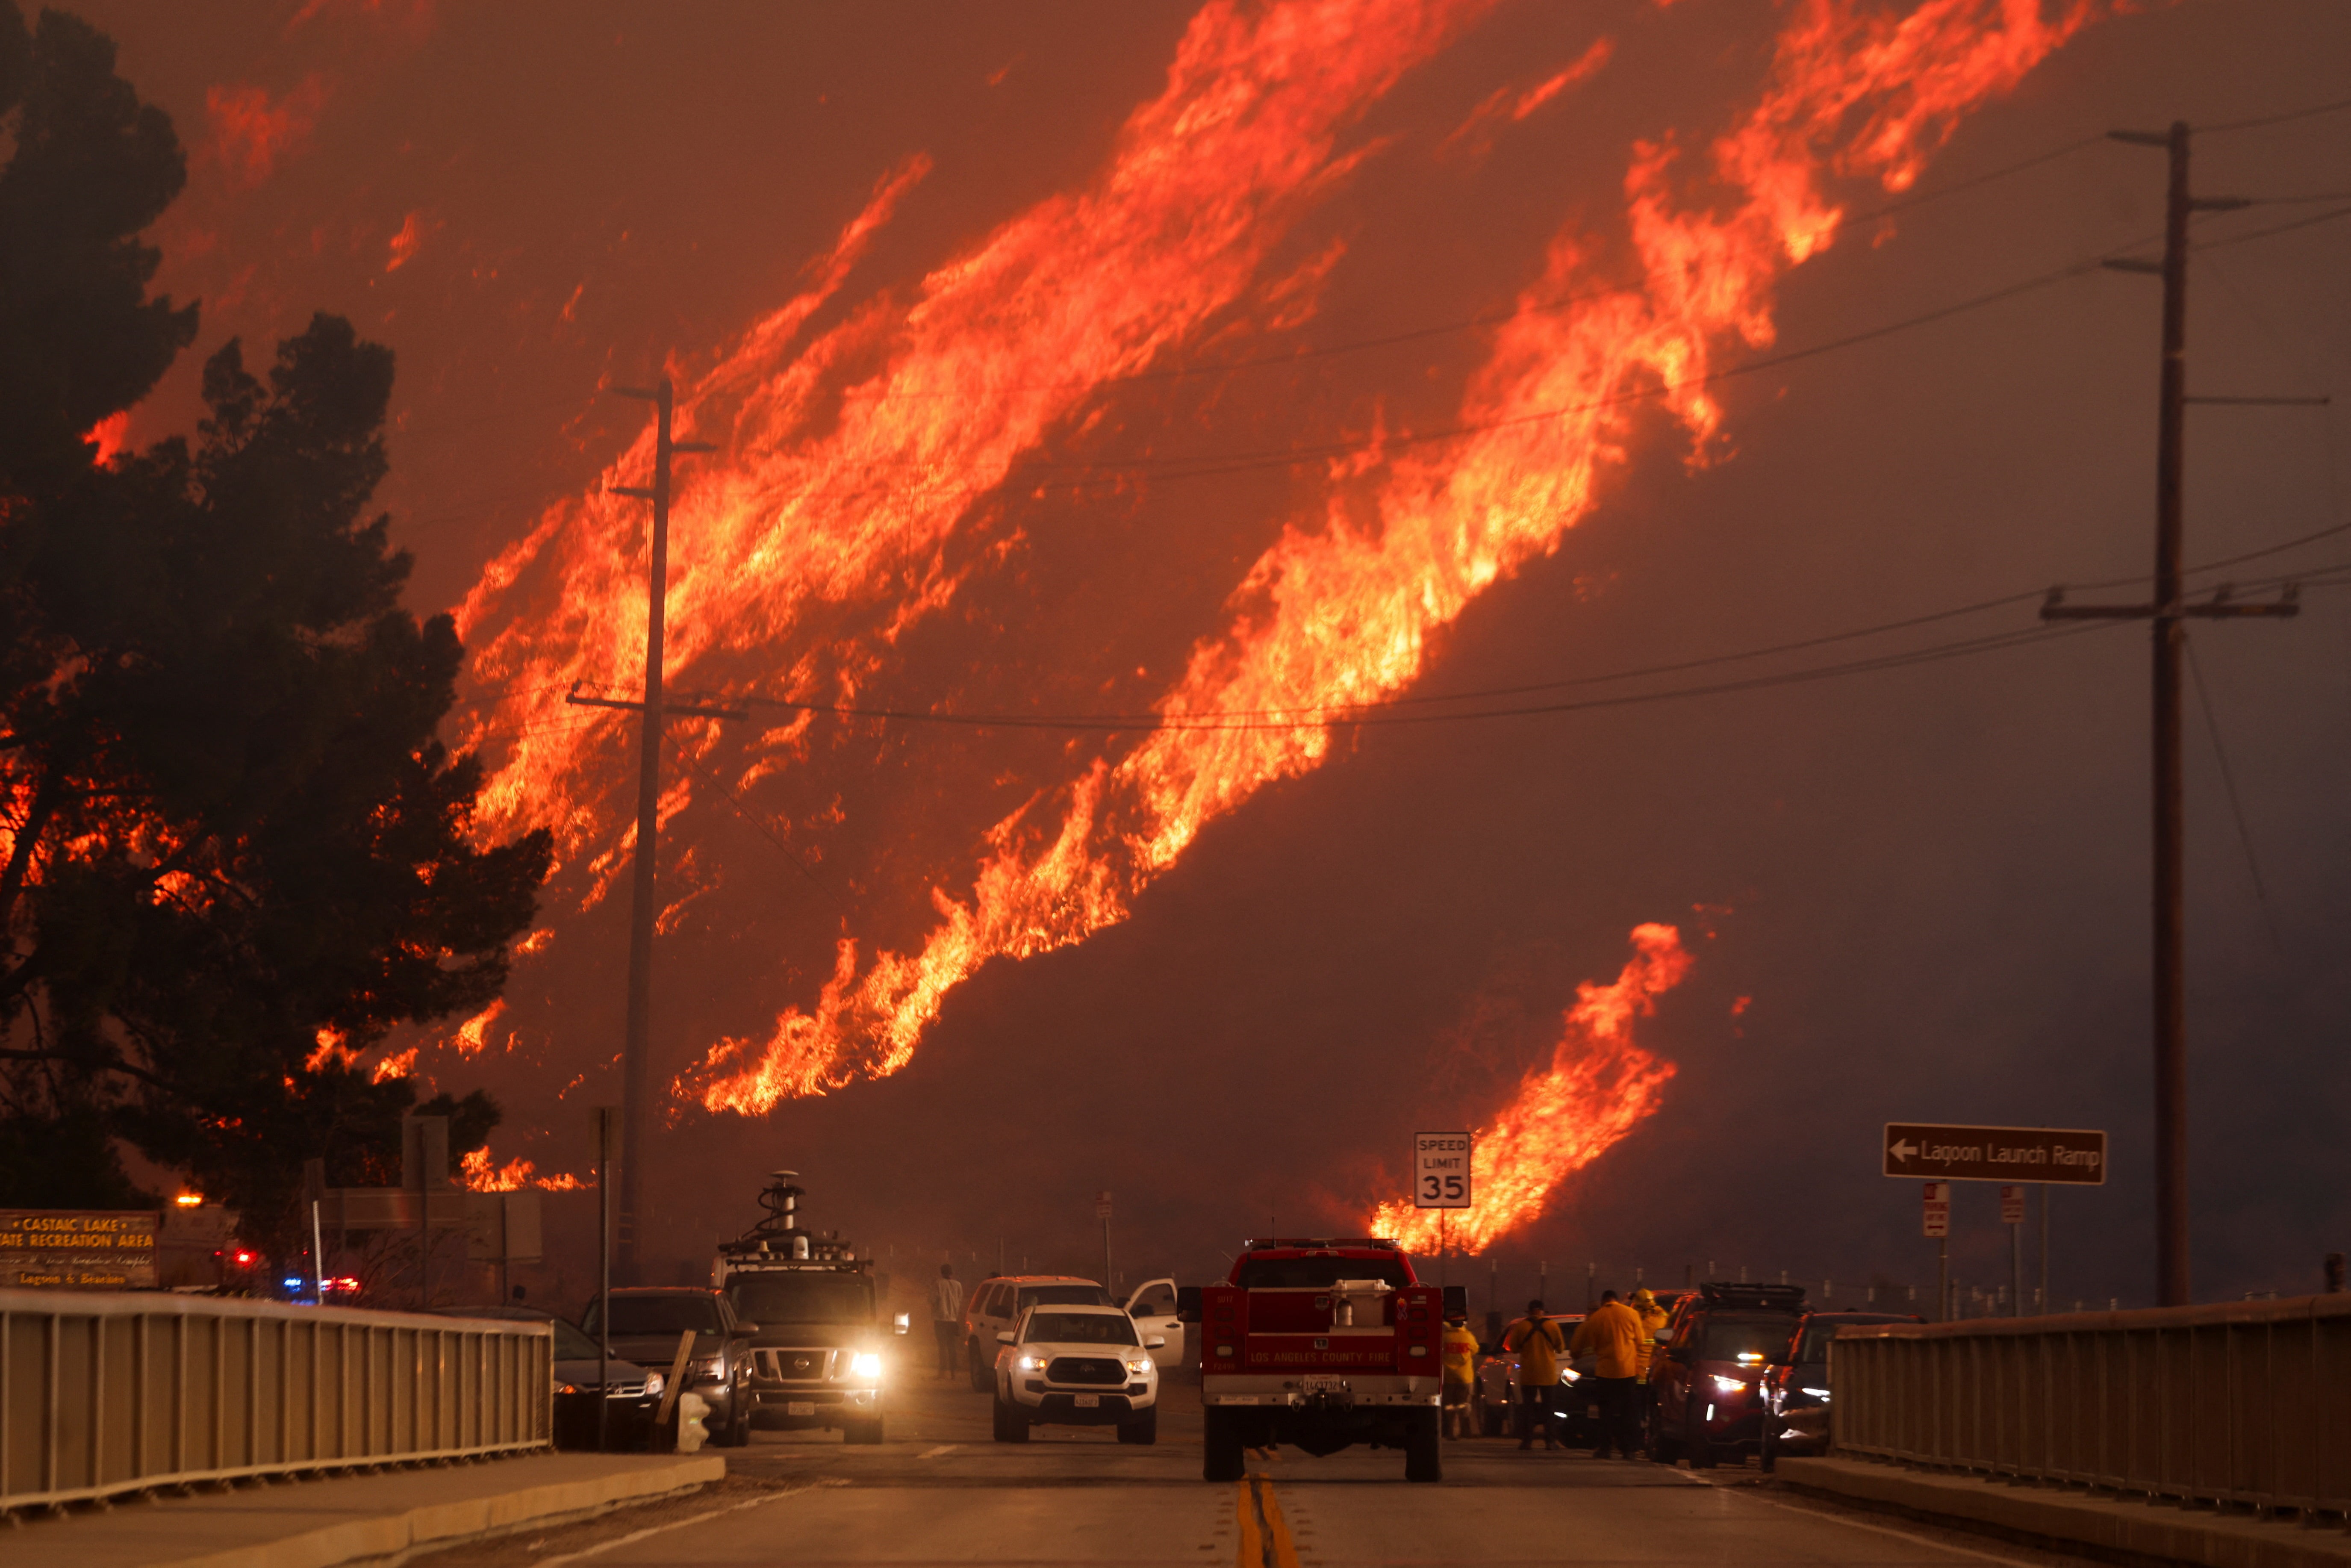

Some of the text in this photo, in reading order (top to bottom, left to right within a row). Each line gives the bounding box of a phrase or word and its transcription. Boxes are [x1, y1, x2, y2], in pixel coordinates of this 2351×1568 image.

[1419, 1141, 1465, 1150] SPEED
[1921, 1140, 2100, 1173] Lagoon Launch Ramp
[1424, 1158, 1460, 1169] LIMIT
[1423, 1176, 1464, 1200] 35
[23, 1218, 118, 1232] CASTAIC LAKE
[29, 1234, 112, 1247] RECREATION
[117, 1234, 154, 1247] AREA
[20, 1273, 126, 1286] Lagoon & Beaches
[1251, 1352, 1390, 1362] LOS ANGELES COUNTY FIRE
